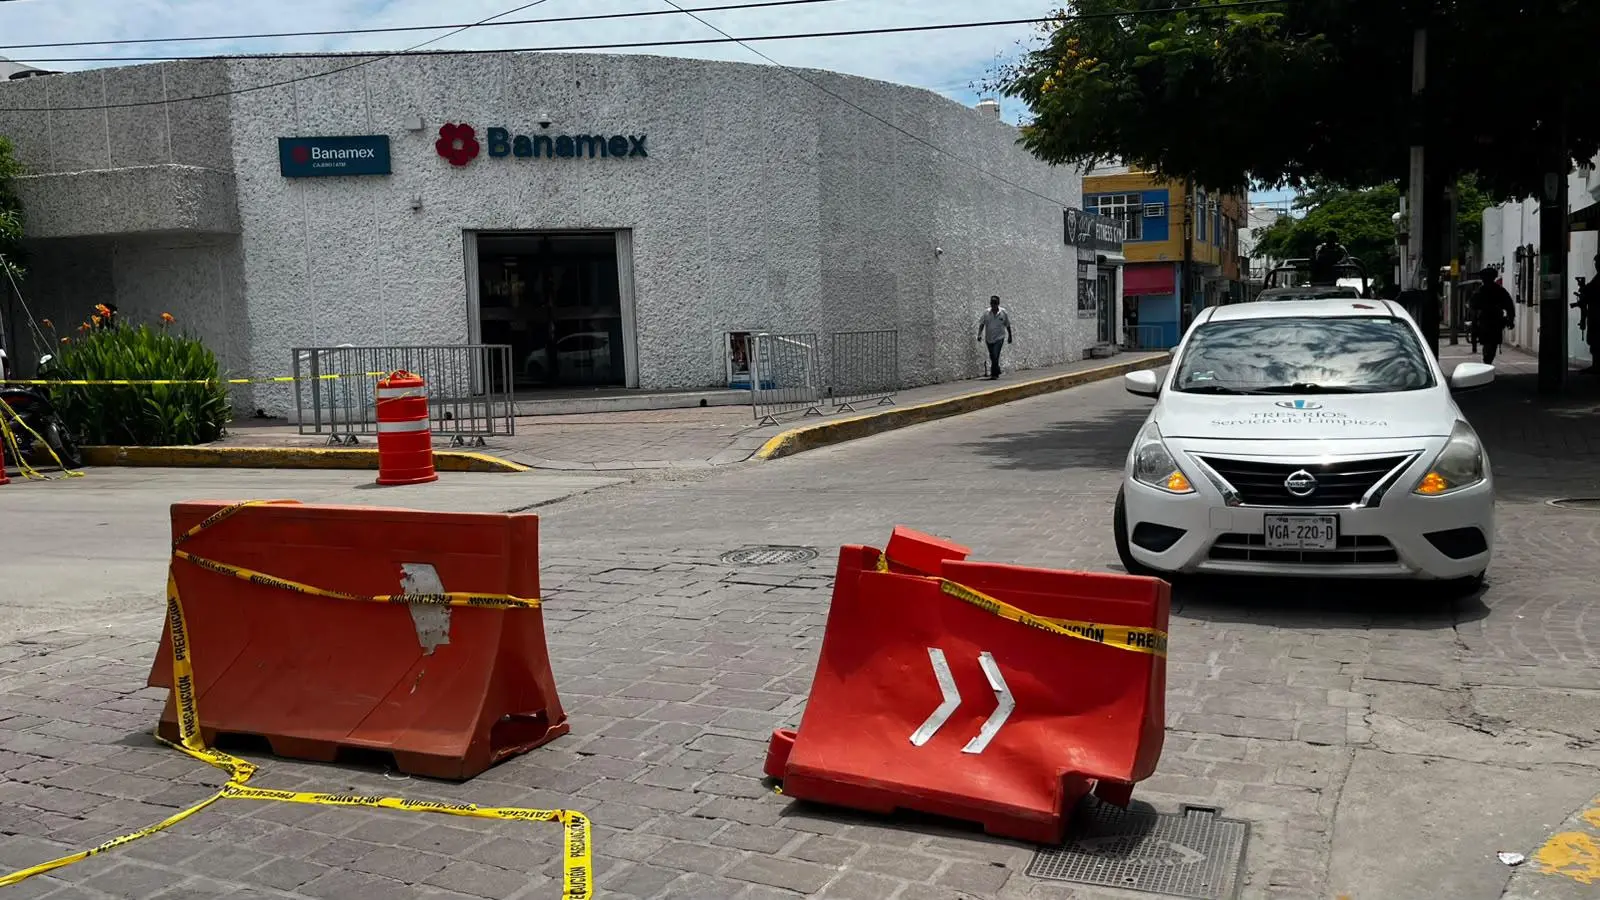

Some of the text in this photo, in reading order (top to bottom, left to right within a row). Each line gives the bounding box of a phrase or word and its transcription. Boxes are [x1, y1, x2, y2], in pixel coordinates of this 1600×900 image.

[487, 126, 648, 159] Banamex
[311, 146, 375, 159] Banamex
[1211, 417, 1277, 426] Servicio
[1308, 417, 1388, 428] Limpieza
[1251, 411, 1297, 419] TRES
[1267, 523, 1334, 541] VGA-220-D
[176, 674, 195, 738] PRECAUCIÓN
